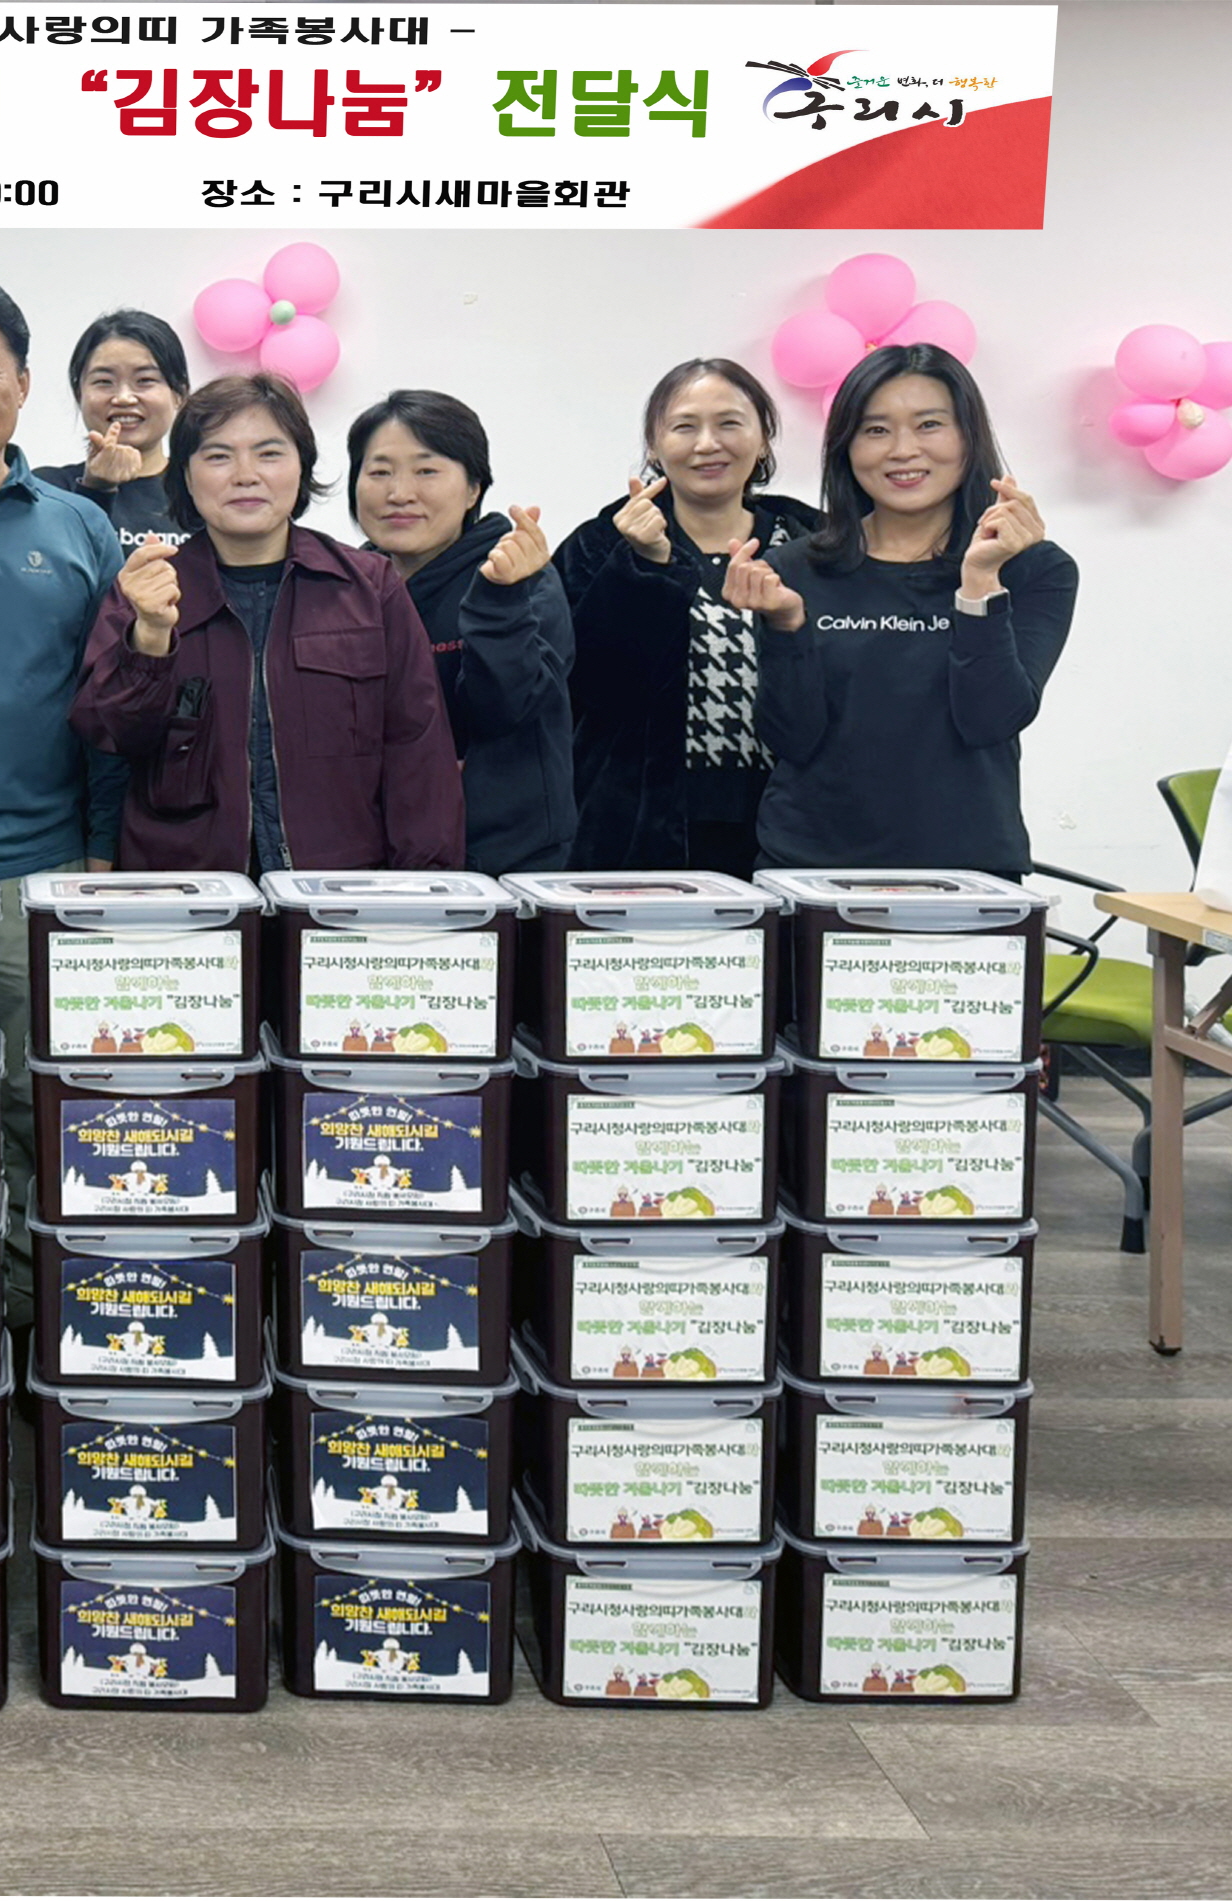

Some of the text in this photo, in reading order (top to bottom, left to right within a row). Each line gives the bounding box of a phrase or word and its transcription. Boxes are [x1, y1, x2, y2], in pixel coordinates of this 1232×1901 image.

[201, 15, 429, 46] 가족봉사대
[491, 69, 709, 139] 전달식
[773, 91, 965, 131] 구리시
[201, 179, 276, 208] 장소
[318, 179, 631, 208] 구리시새마을회관
[816, 615, 950, 632] Calvin Klein Je
